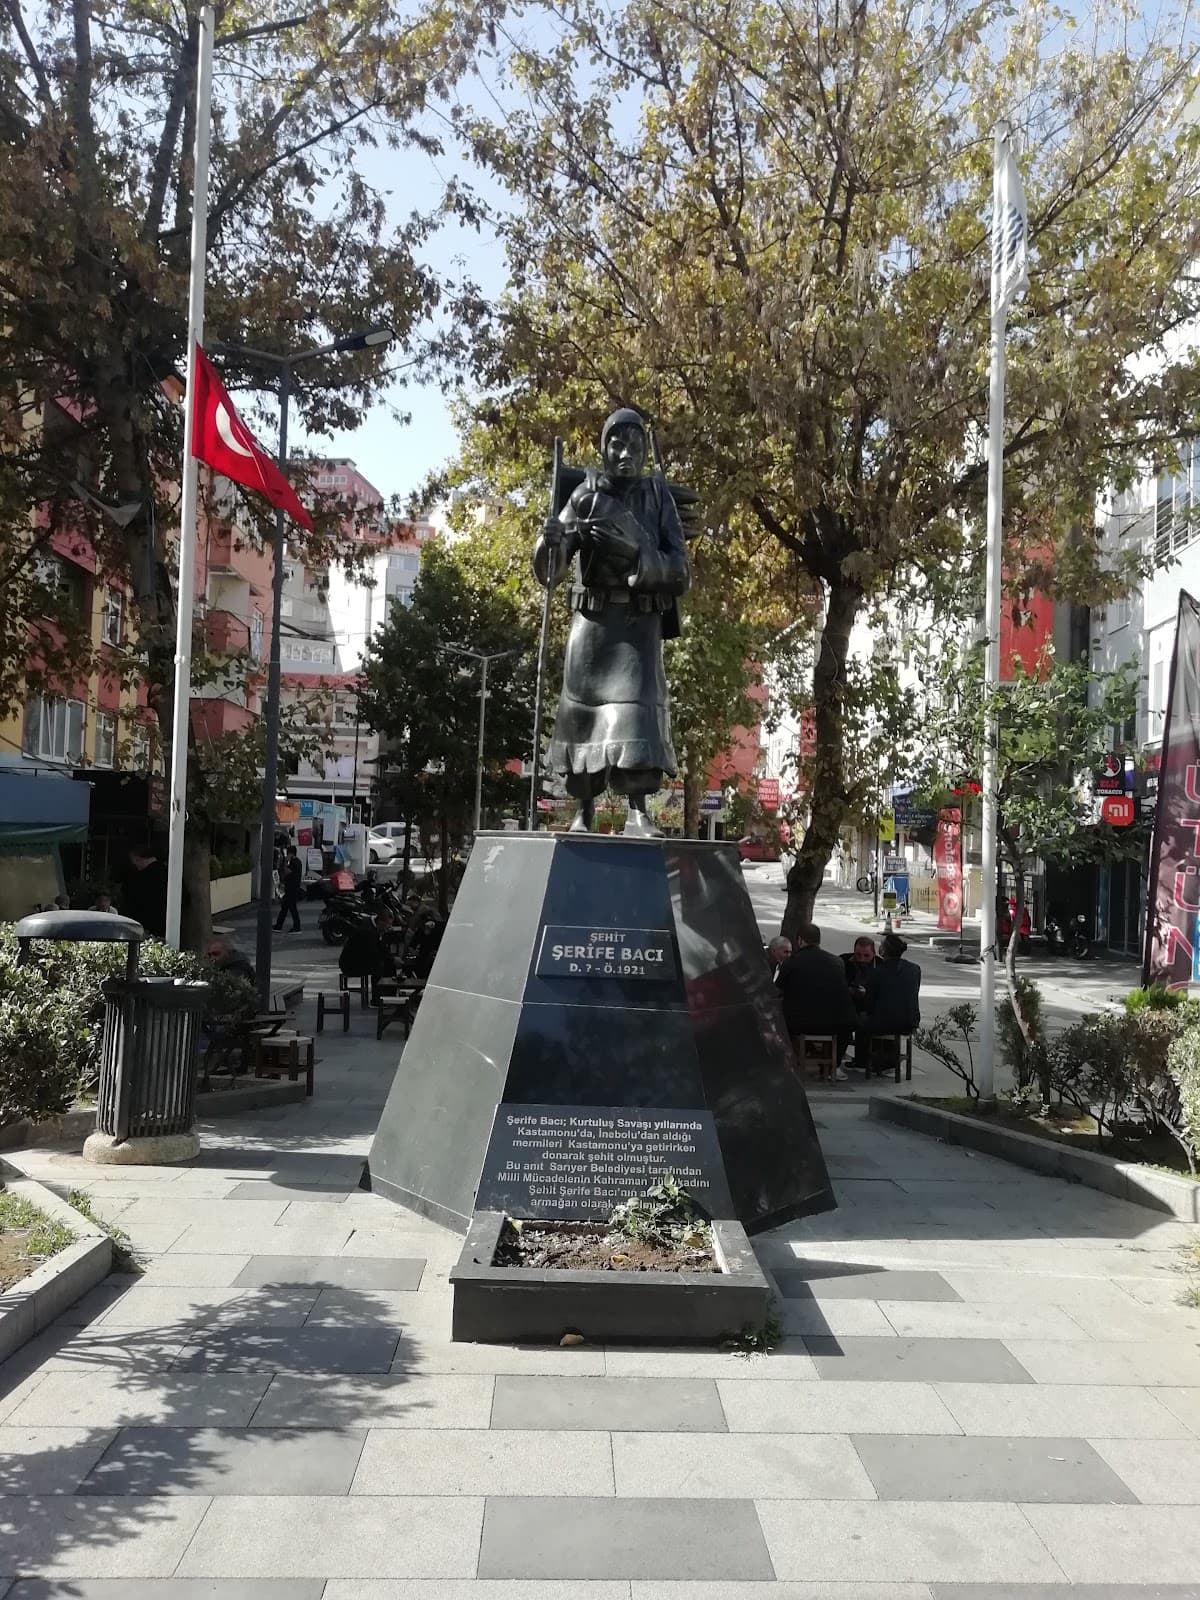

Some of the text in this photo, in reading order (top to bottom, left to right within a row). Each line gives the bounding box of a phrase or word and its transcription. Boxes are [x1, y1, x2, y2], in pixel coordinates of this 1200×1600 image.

[590, 931, 626, 943] ŞEHİT
[551, 943, 664, 962] ŞERİFE BACI
[569, 963, 582, 972] D.
[585, 963, 592, 972] ?
[506, 1115, 702, 1131] Şerife Bacı; Kurtuluş Savaşı yıllarında
[517, 1127, 692, 1143] Kastamonu'da, İnebolu'dan aldığı
[512, 1138, 696, 1153] mermileri Kastamonu'ya getirirken
[542, 1150, 667, 1165] donarak şehit olmuştur.
[506, 1160, 702, 1176] Bu anıt Sarıyer Belediyesi tarafından
[497, 1172, 520, 1182] Milli
[522, 1173, 591, 1184] Mücadelenin
[593, 1174, 648, 1186] Kahraman
[528, 1184, 557, 1196] Şehit
[559, 1186, 591, 1197] Şerife
[593, 1187, 637, 1198] Bacı'nın
[530, 1198, 578, 1209] armağan
[580, 1199, 614, 1210] olarak
